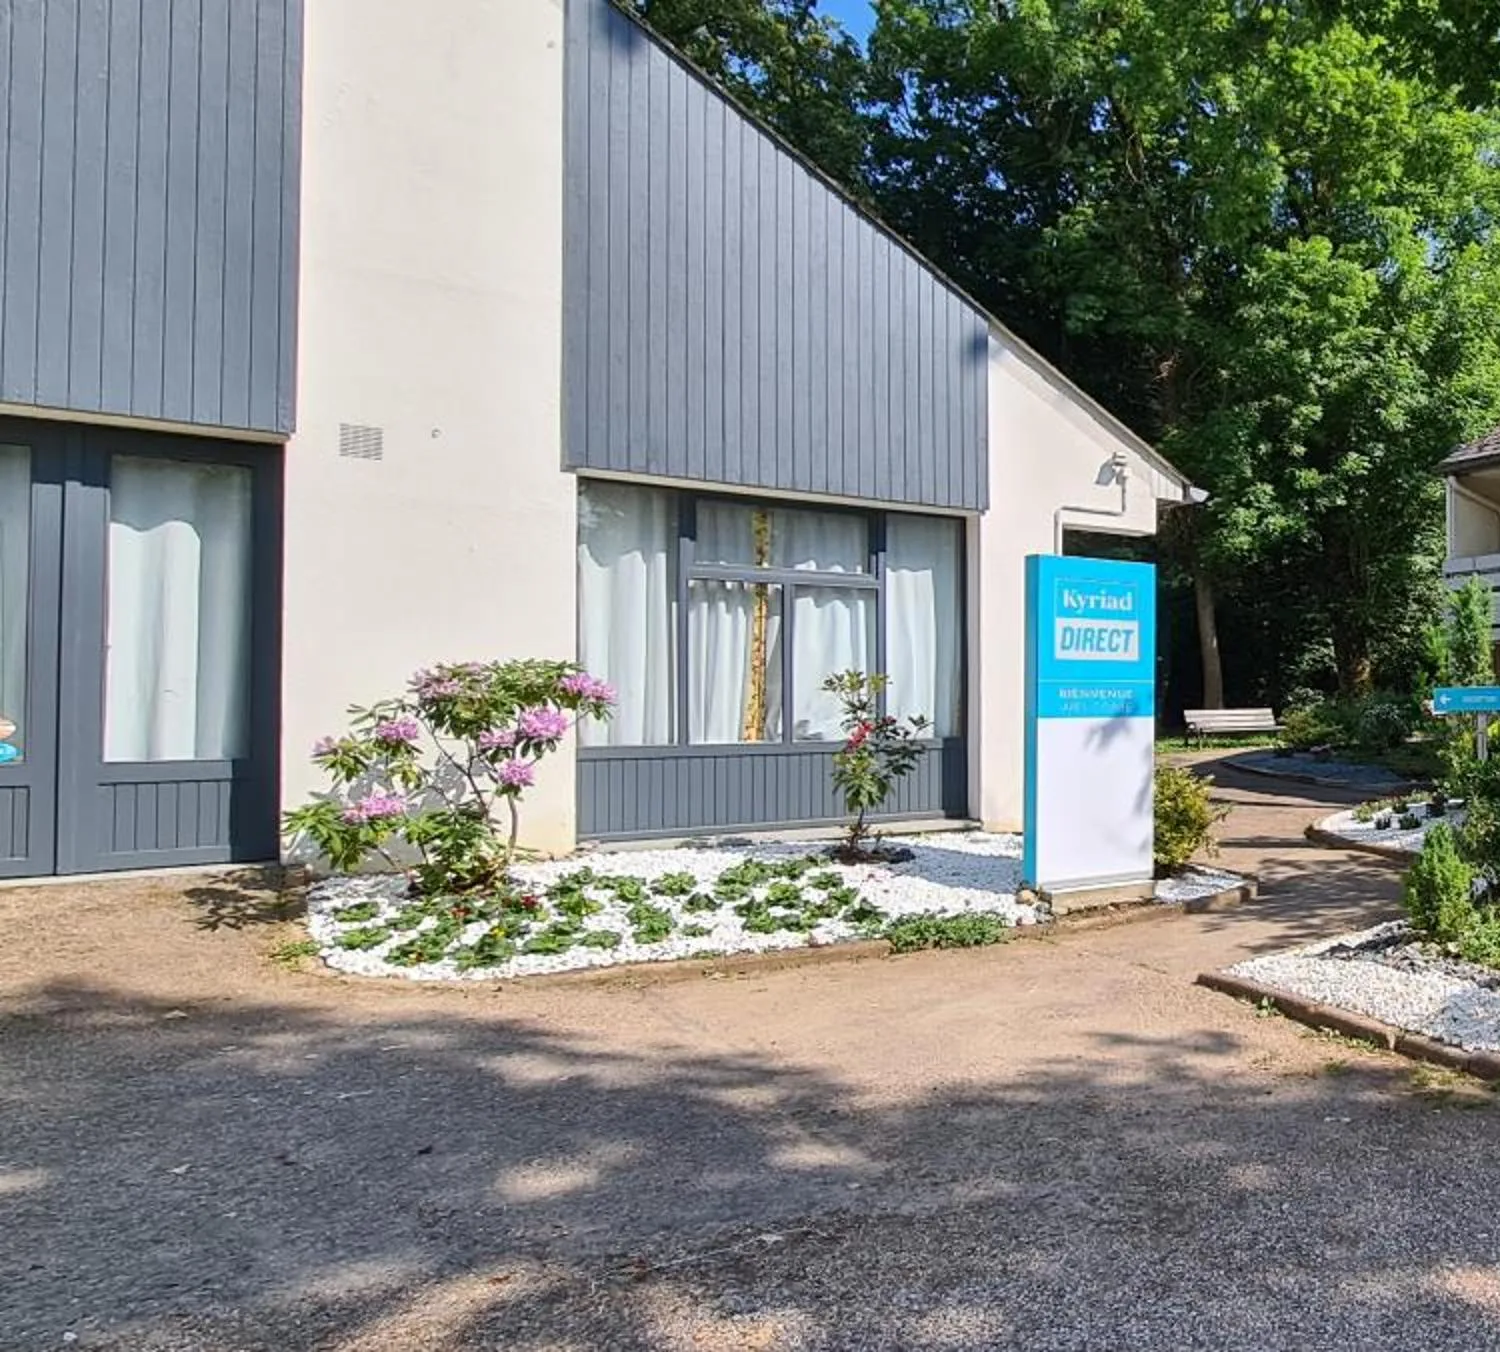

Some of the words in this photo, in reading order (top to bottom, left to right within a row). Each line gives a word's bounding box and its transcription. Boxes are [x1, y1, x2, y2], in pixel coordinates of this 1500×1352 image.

[1063, 589, 1134, 614] Kyriad
[1060, 626, 1135, 653] DIRECT
[1058, 687, 1134, 699] BIENVENUE
